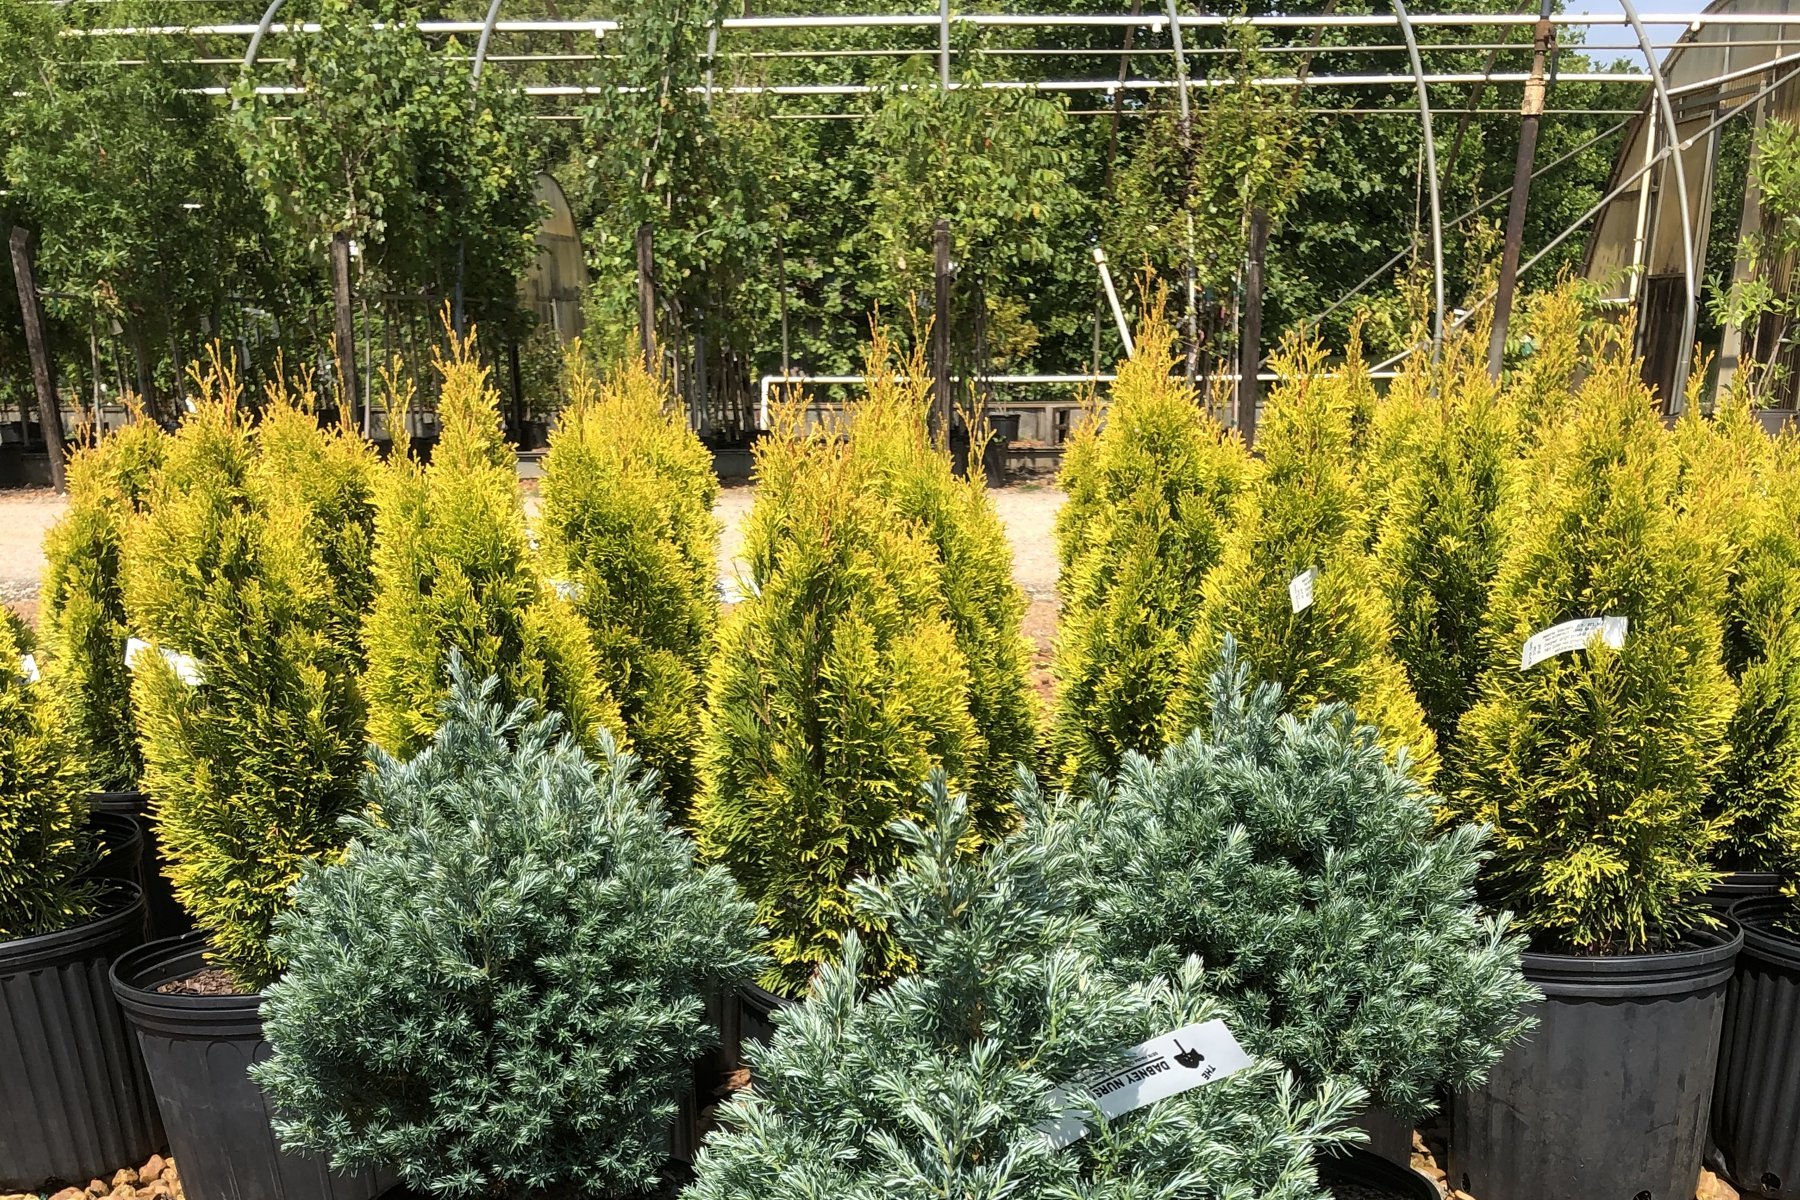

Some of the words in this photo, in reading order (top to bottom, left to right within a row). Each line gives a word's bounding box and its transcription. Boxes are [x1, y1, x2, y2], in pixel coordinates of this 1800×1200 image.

[1128, 1061, 1170, 1084] DABNEY
[1201, 1064, 1216, 1080] THE
[1092, 1081, 1125, 1100] NURS
